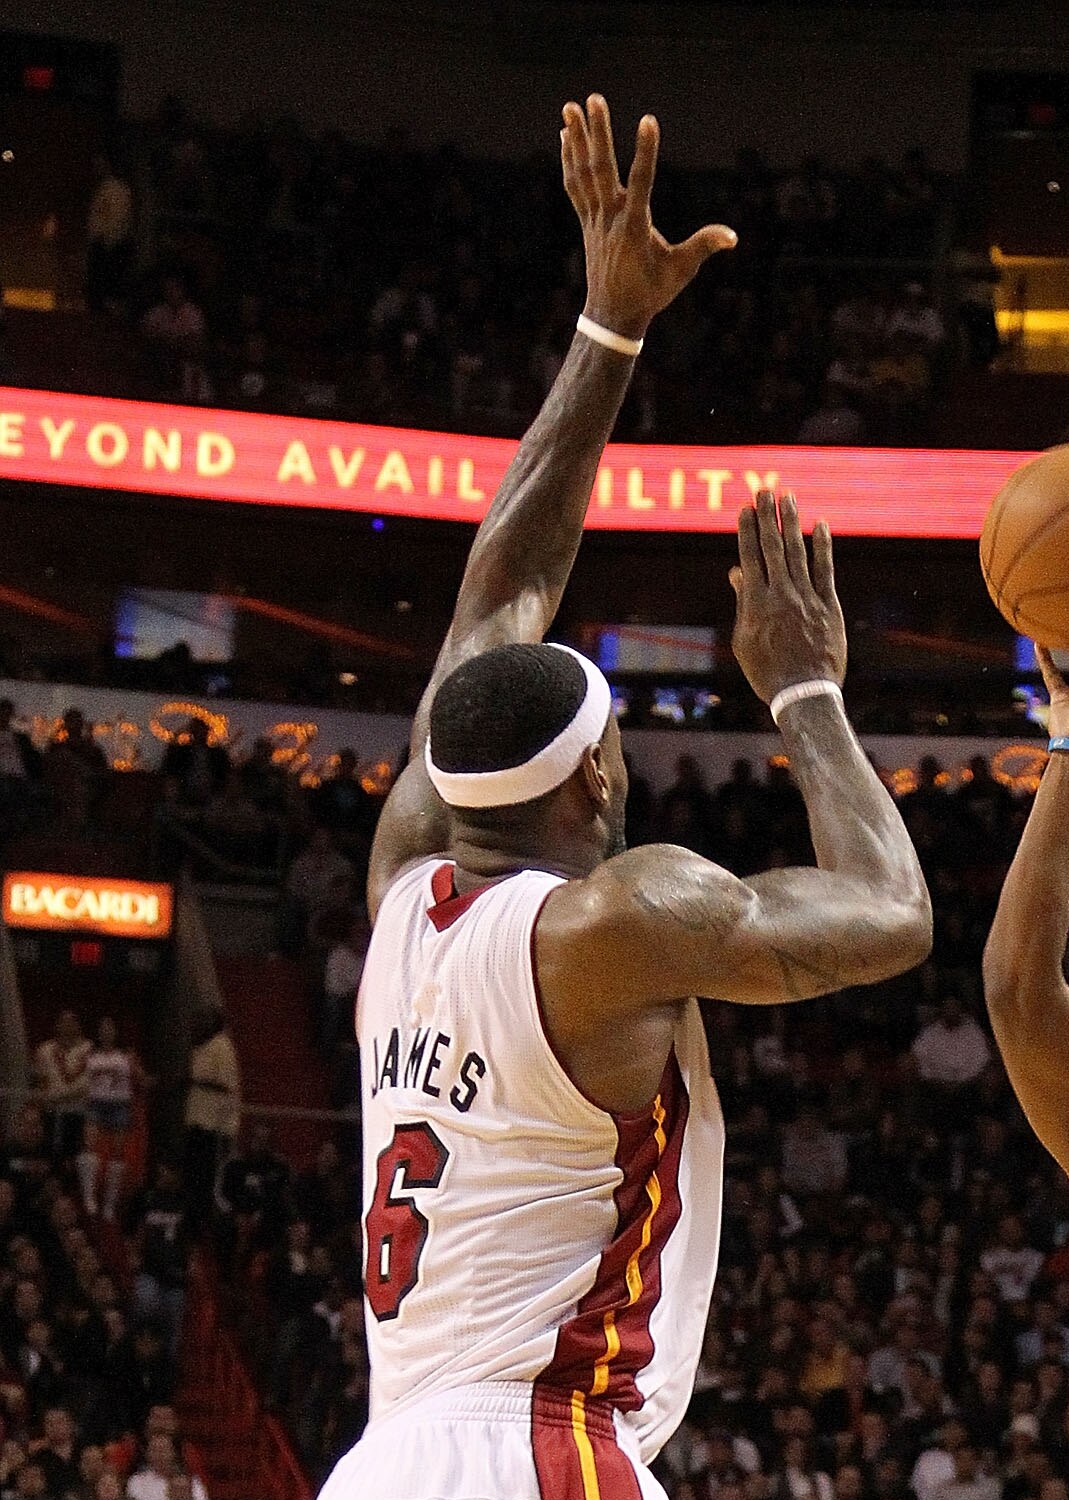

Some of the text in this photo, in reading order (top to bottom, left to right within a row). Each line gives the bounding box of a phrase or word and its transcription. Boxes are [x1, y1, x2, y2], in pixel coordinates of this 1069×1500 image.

[11, 883, 159, 924] BACARDI
[372, 1026, 486, 1113] JAMES
[364, 1120, 450, 1322] 6
